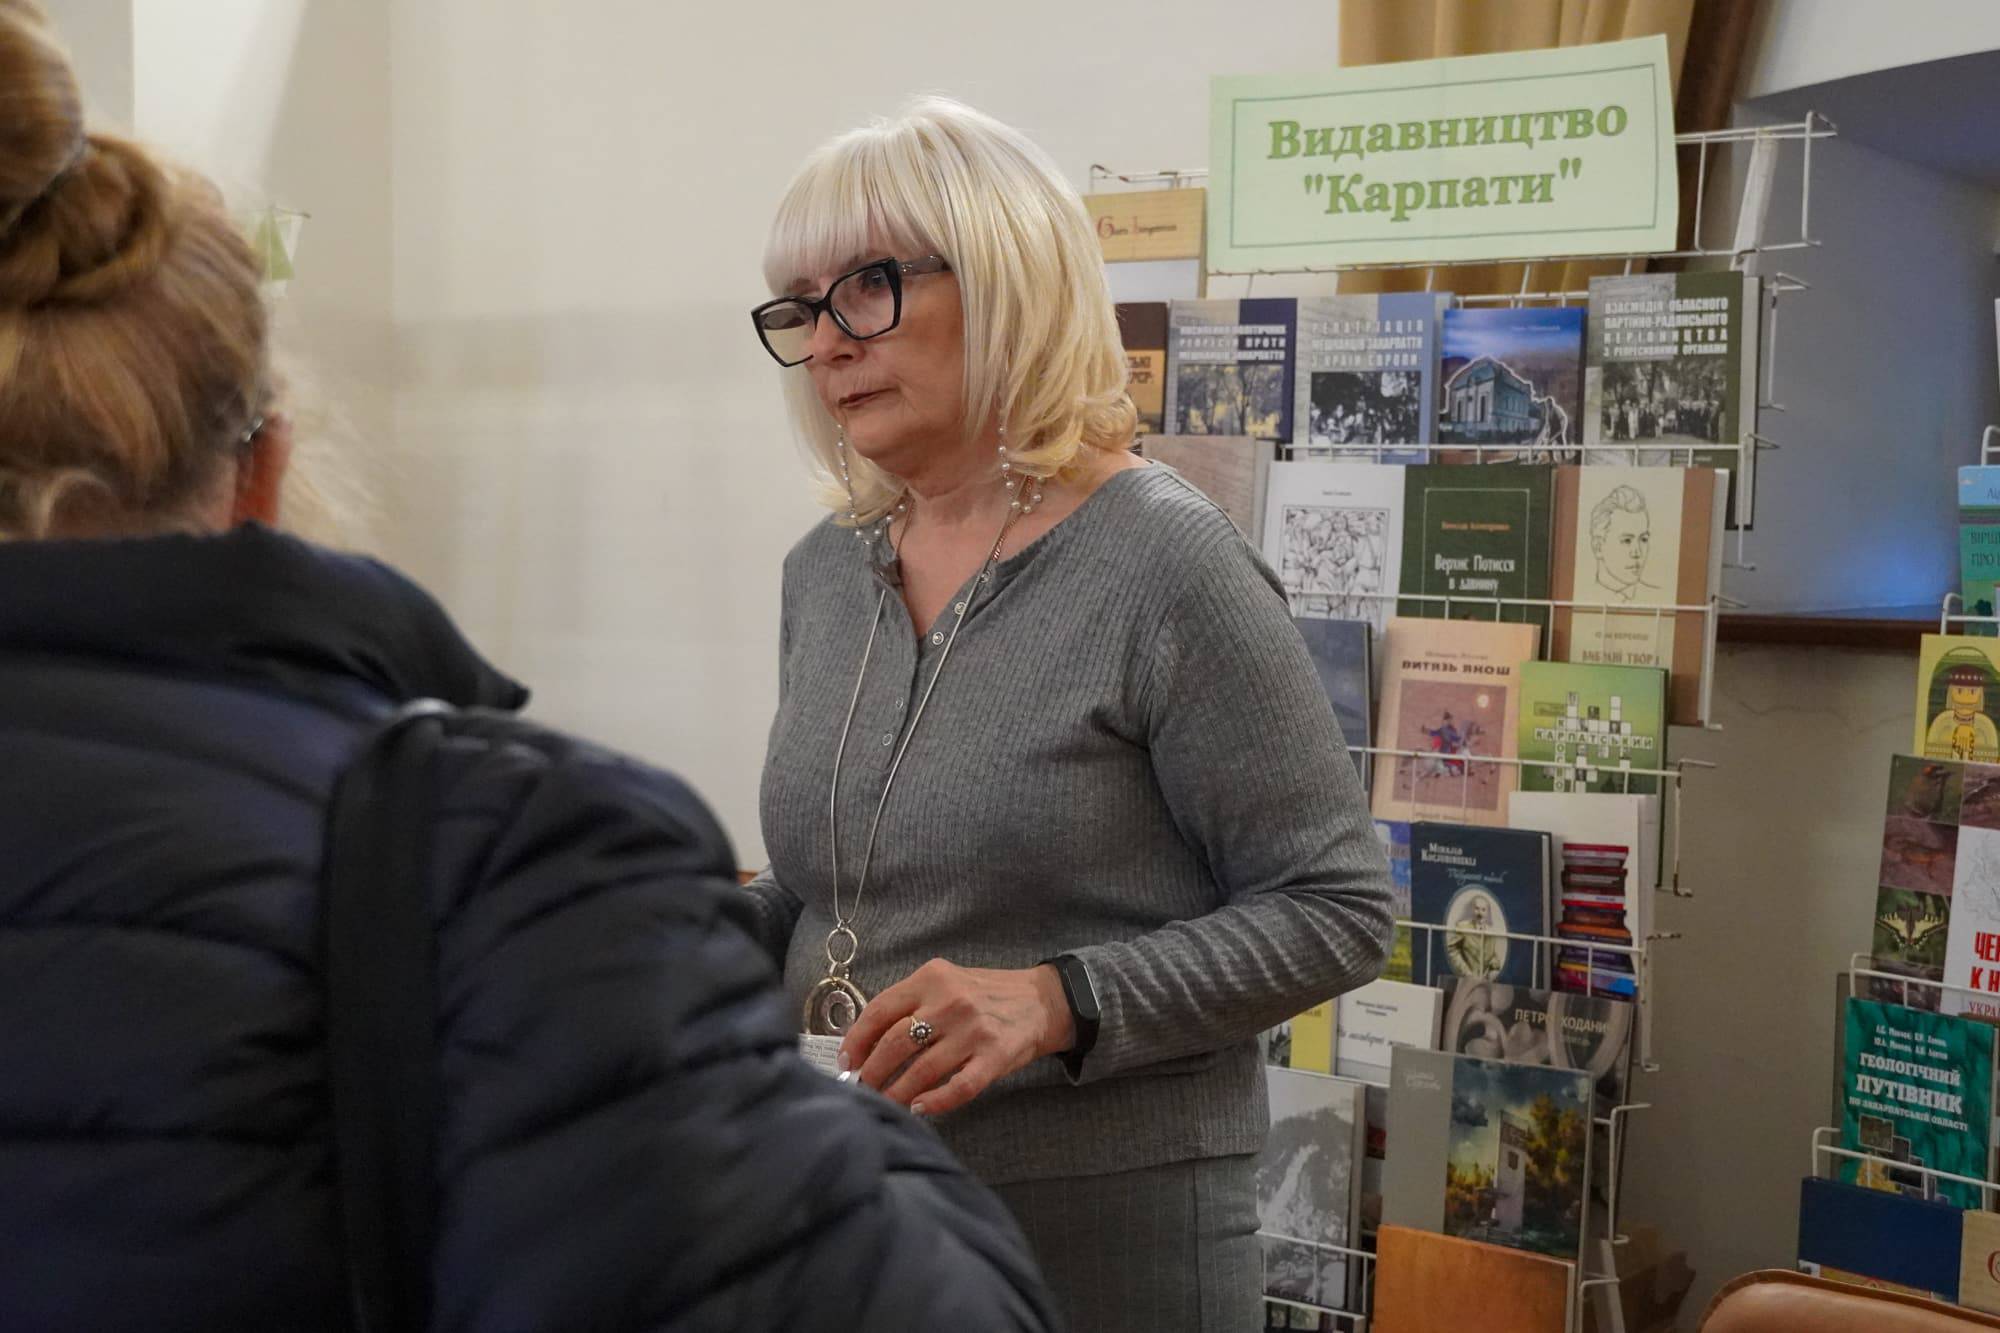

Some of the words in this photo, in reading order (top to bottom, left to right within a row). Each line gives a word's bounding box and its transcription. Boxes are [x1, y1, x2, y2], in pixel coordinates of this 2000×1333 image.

[1267, 104, 1629, 162] Видавництво
[1303, 157, 1582, 222] "Карпати"
[1668, 297, 1729, 312] ОБЛАСНОГО
[1401, 660, 1458, 673] ВИТЯЗЬ
[1462, 663, 1511, 676] ЯНОШ
[1560, 1015, 1616, 1033] ХОДАНИ
[1859, 1052, 1961, 1087] ГЕОЛОГІЧНИЙ
[1856, 1073, 1963, 1115] ПУТІВНИК
